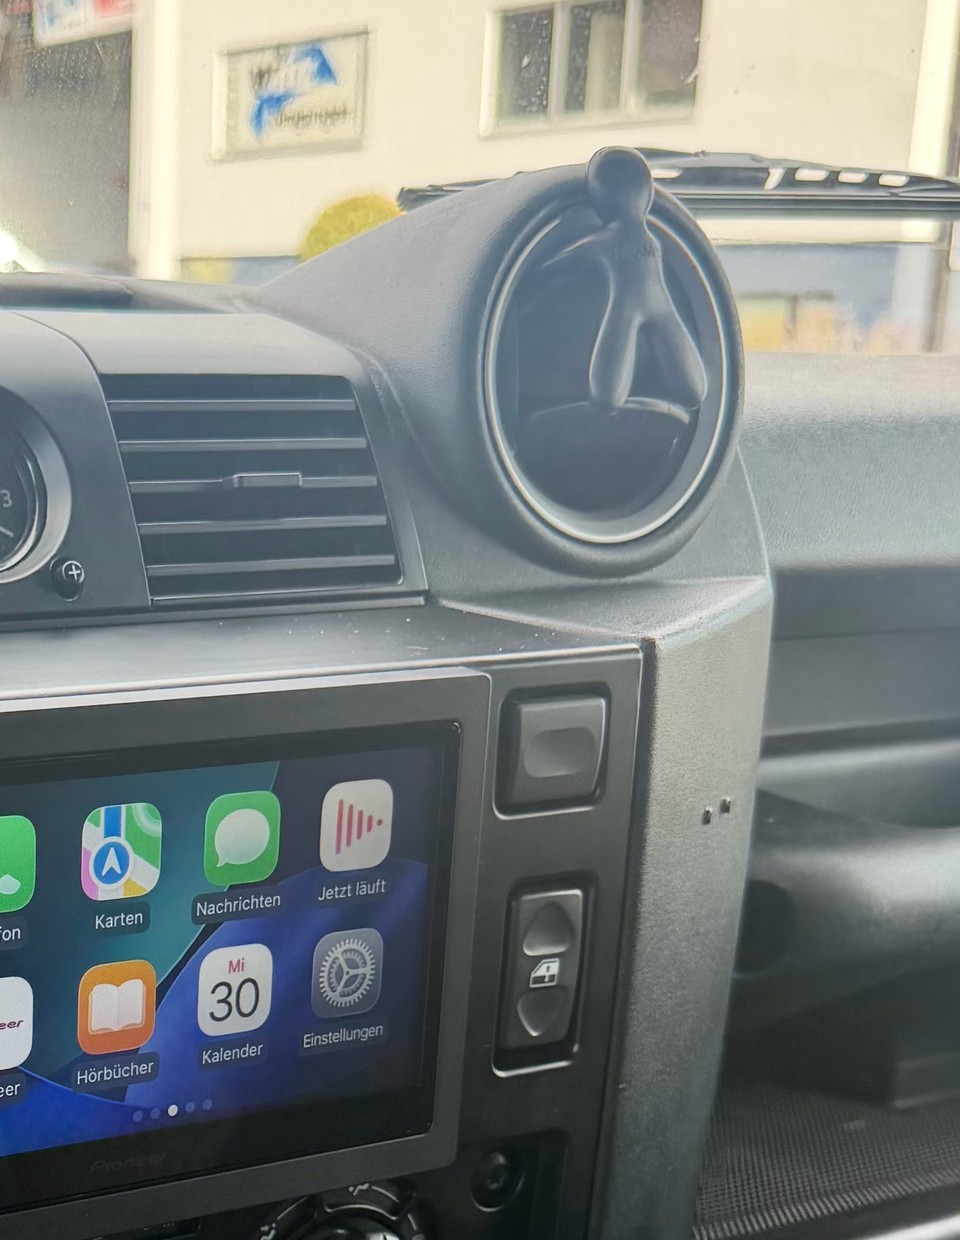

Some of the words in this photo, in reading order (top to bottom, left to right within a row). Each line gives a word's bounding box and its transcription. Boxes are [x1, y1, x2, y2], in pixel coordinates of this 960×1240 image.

[0, 489, 13, 508] 3
[318, 884, 352, 902] Jetzt
[354, 878, 387, 898] läuft
[196, 892, 282, 917] Nachrichten
[95, 911, 144, 930] Karten
[228, 957, 246, 974] Mi
[208, 976, 261, 1023] 30
[303, 1023, 384, 1049] Einstellungen
[201, 1042, 264, 1065] Kalender
[76, 1060, 155, 1085] Hörbücher
